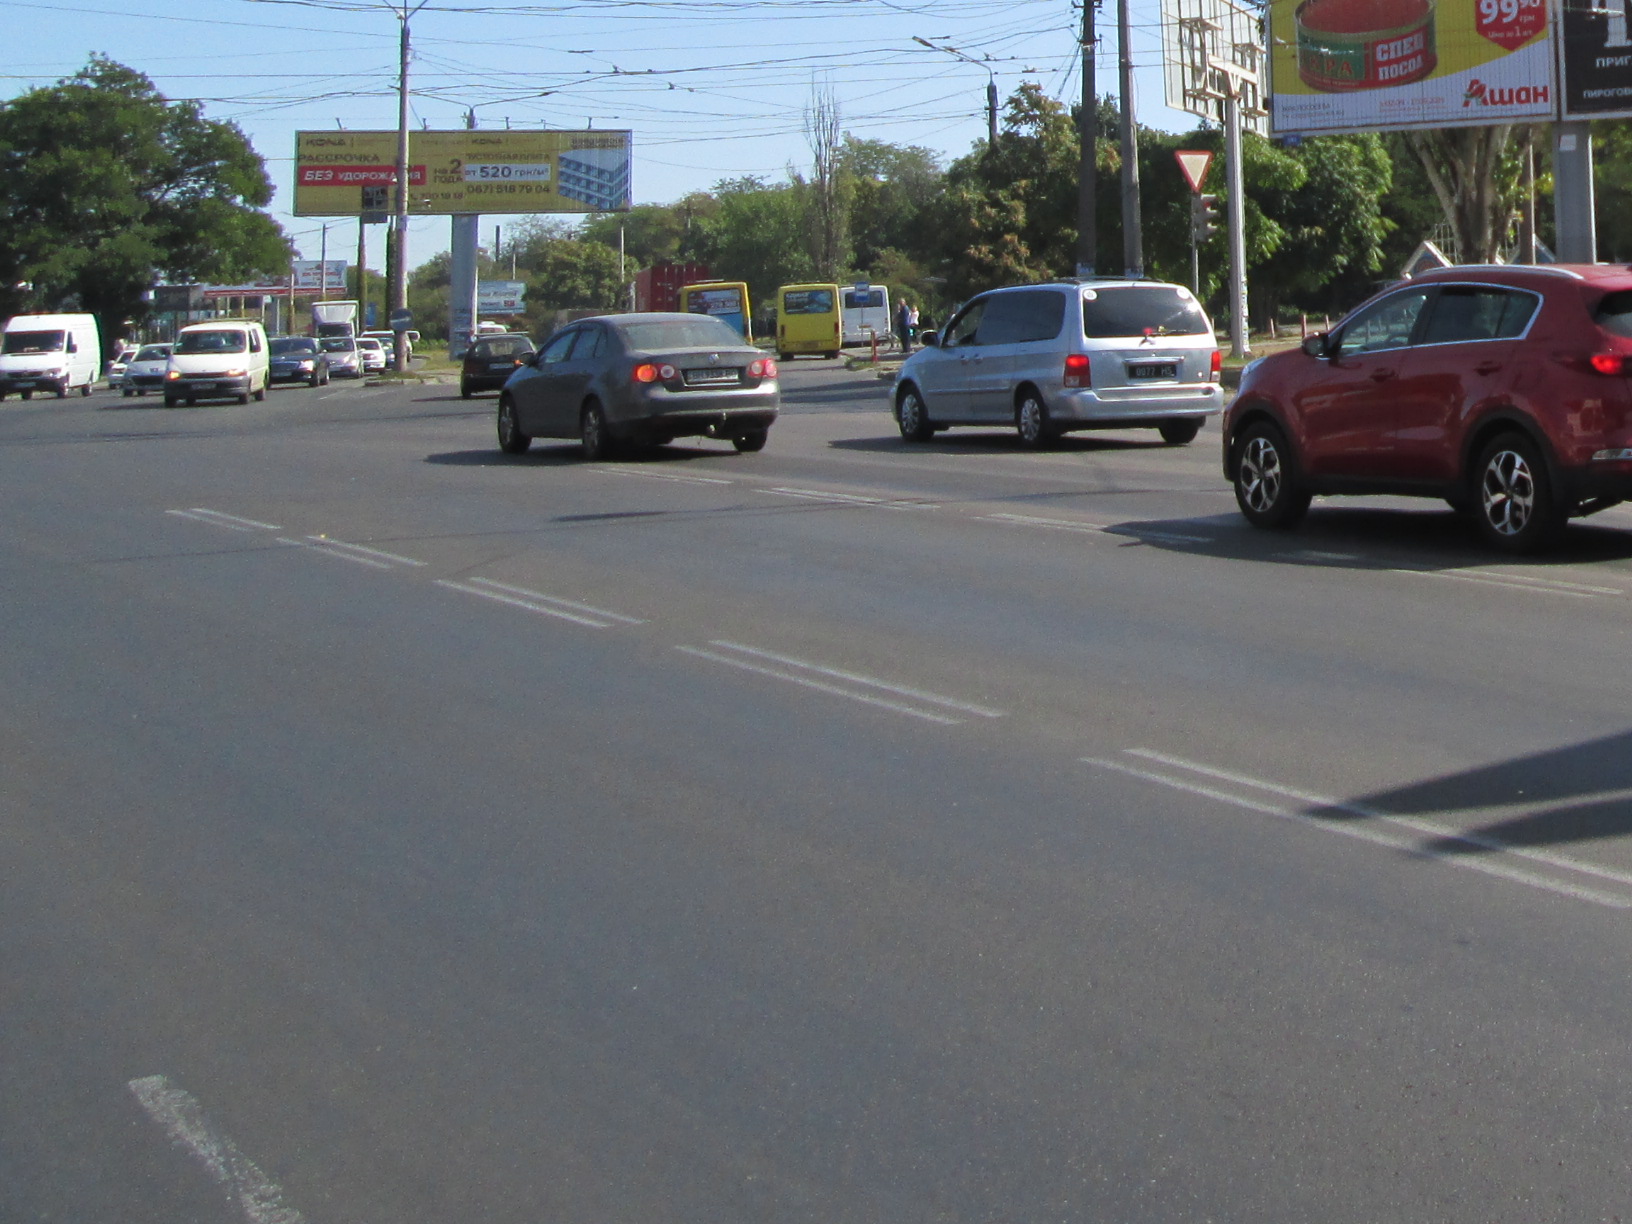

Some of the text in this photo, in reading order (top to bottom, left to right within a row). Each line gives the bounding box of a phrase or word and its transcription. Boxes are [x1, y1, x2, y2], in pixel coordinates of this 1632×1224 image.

[299, 154, 380, 163] РАССРОЧКА
[304, 170, 421, 181] БЕЗ УДОРОЖАИЯ
[480, 166, 512, 178] 520
